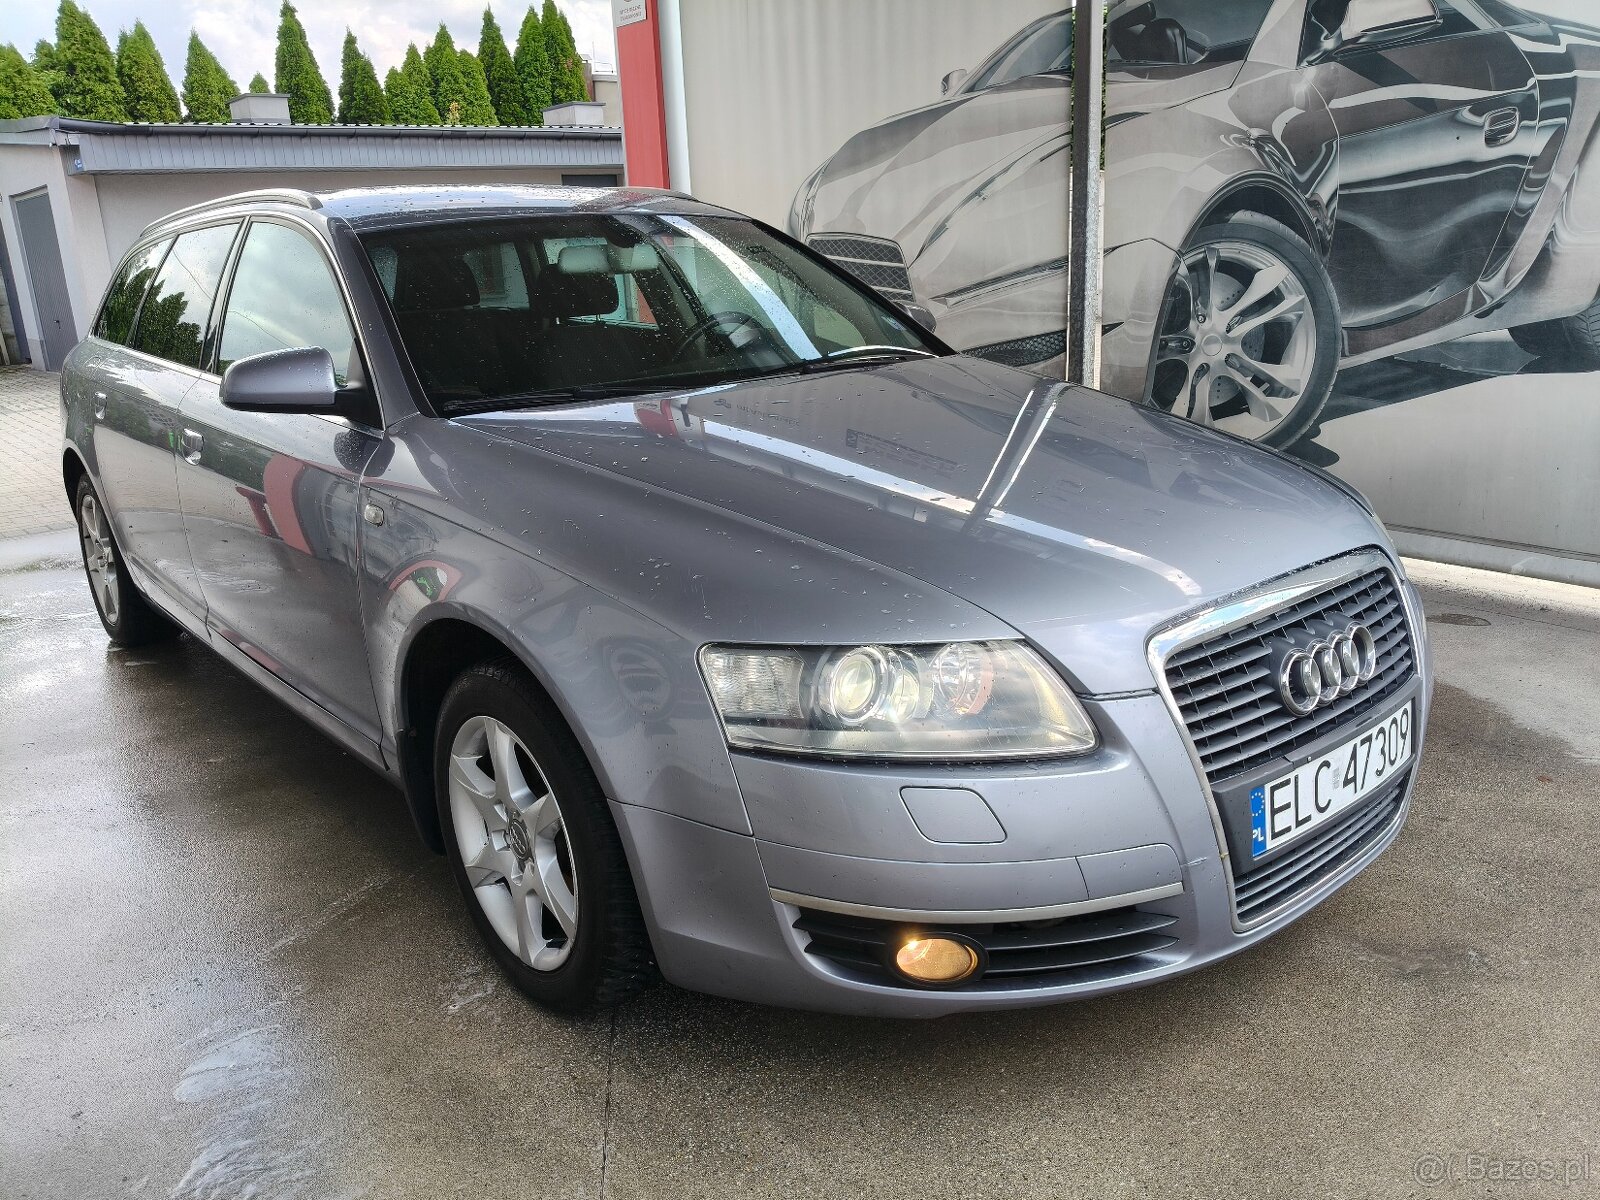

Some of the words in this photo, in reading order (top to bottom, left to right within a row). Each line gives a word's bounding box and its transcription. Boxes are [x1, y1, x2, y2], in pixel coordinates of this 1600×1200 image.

[1269, 770, 1332, 840] ELC
[1342, 707, 1409, 794] 47309
[1252, 826, 1265, 842] PL
